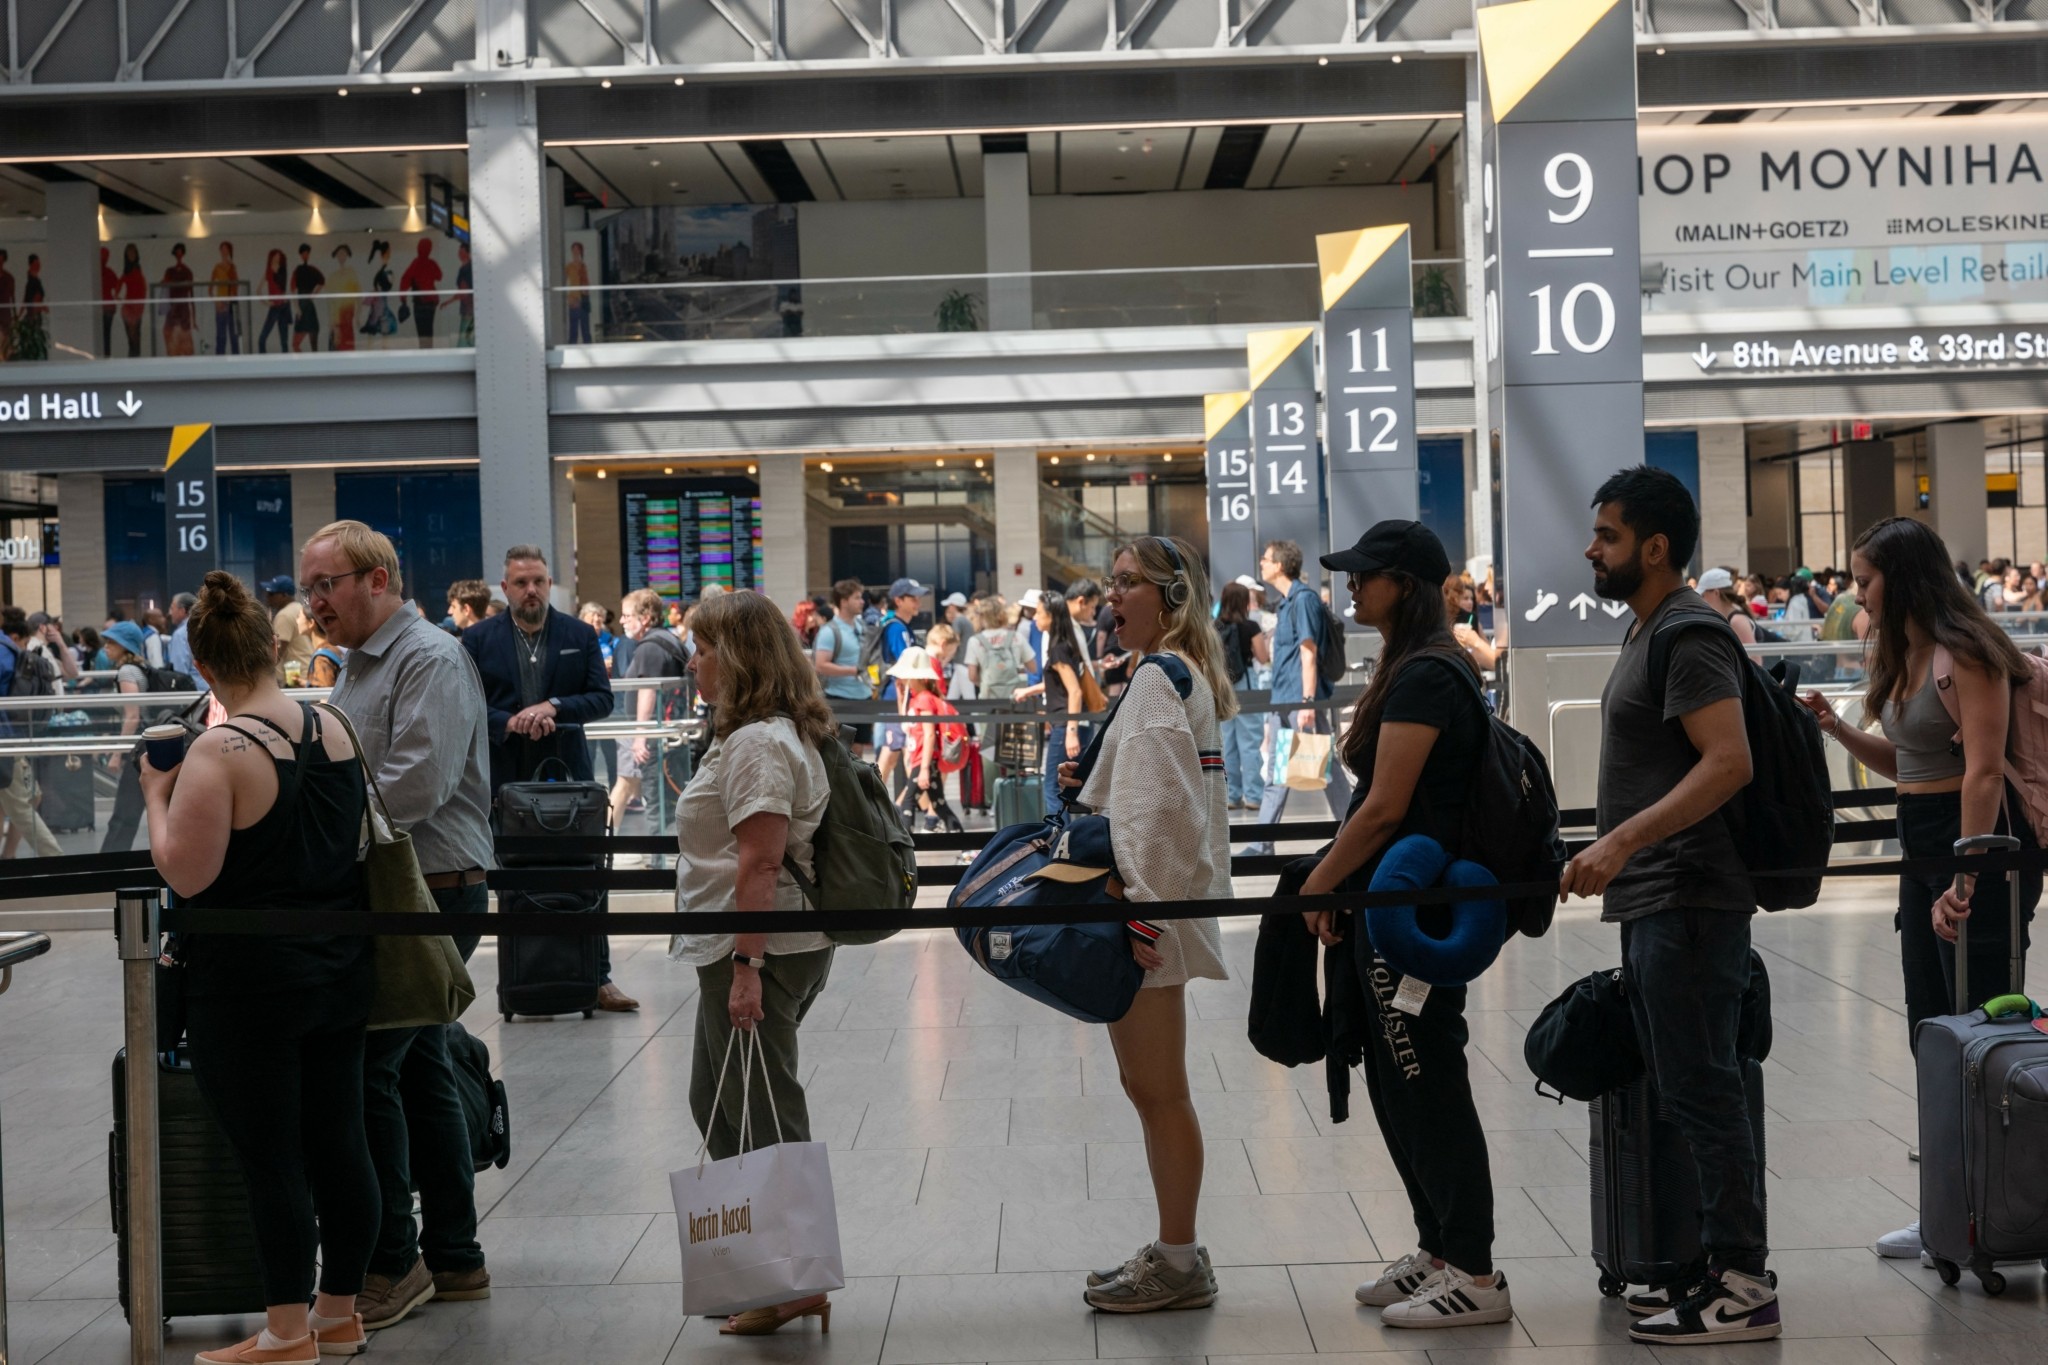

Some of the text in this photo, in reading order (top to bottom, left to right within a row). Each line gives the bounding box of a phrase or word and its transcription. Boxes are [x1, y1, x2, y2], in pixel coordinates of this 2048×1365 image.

[1761, 142, 2043, 191] MOYNIHA
[1544, 152, 1593, 224] 9
[1675, 220, 1849, 242] (MALIN+GOETZ)
[1664, 251, 2048, 292] isit Our Main Level Retail
[1528, 282, 1616, 356] 10
[1346, 327, 1391, 373] 11
[1733, 331, 2048, 369] 8th Avenue & 33rd St
[41, 391, 102, 419] Hall
[1266, 402, 1305, 436] 13
[1345, 407, 1399, 452] 12
[1217, 449, 1248, 476] 15
[1266, 460, 1308, 495] 14
[177, 480, 206, 507] 15
[1220, 494, 1250, 521] 16
[179, 524, 208, 552] 16
[689, 1197, 752, 1245] karin kasaj
[711, 1246, 730, 1257] Wien
